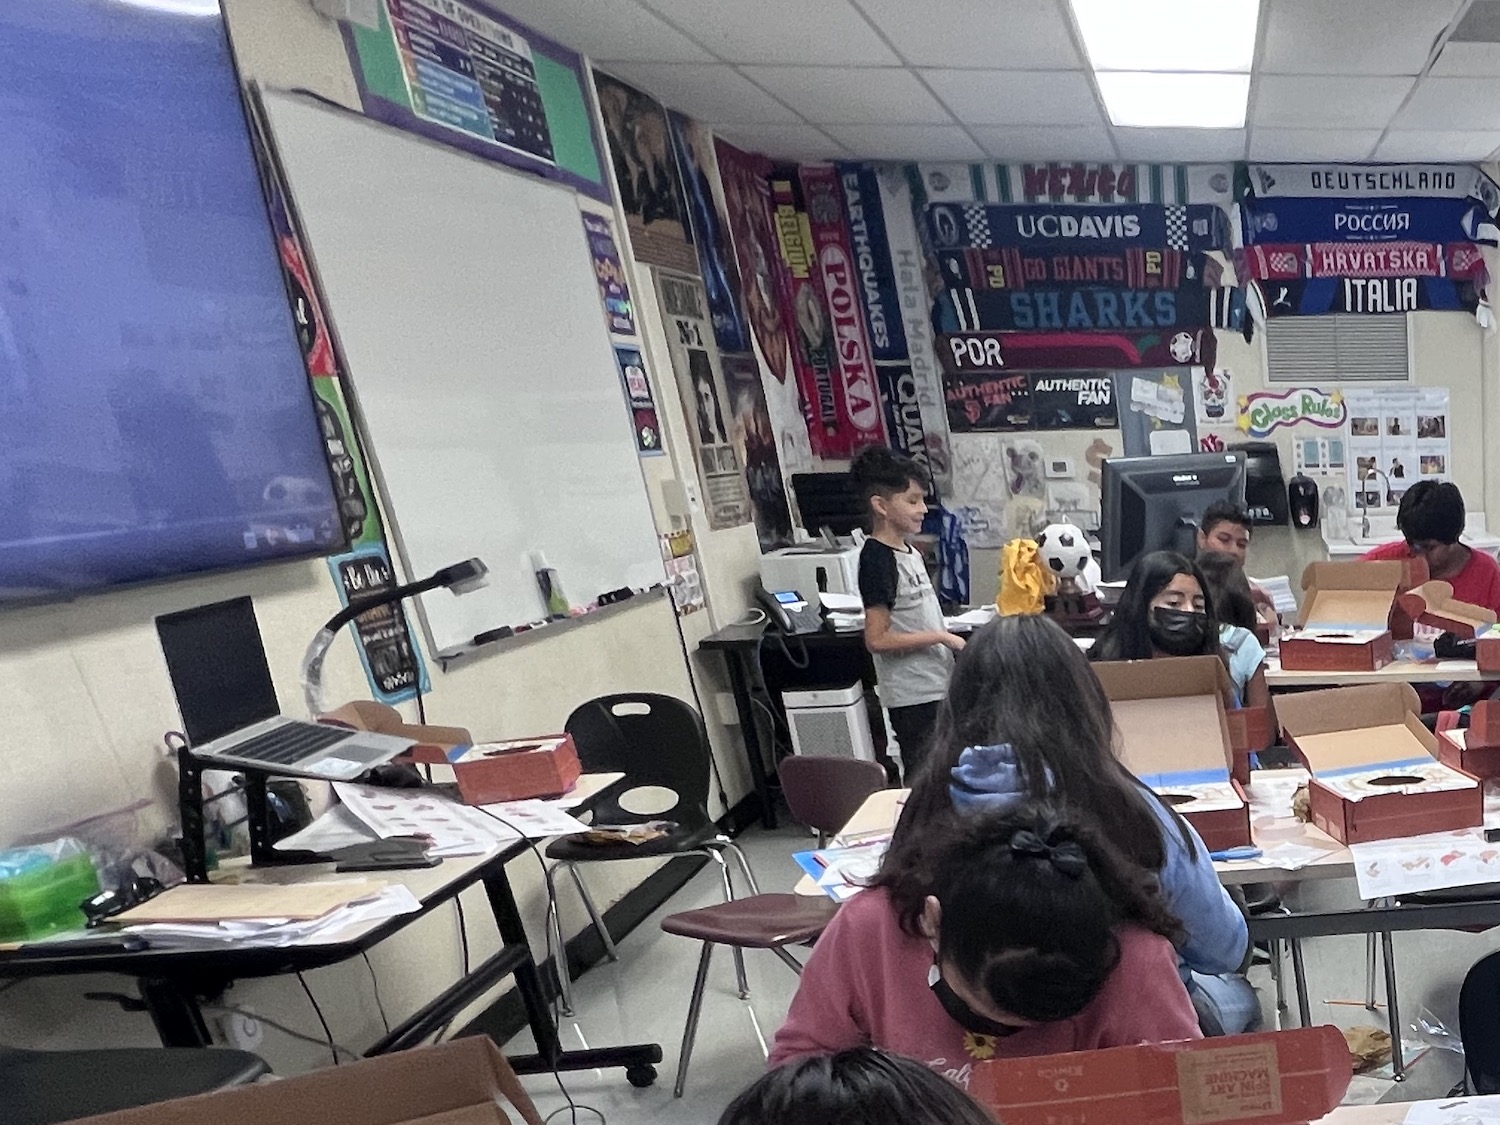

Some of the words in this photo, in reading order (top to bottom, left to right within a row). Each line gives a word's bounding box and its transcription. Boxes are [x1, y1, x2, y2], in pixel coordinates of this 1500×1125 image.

[1311, 171, 1456, 190] DEUTSCHLAND
[1334, 212, 1411, 232] РОССИЯ
[843, 174, 890, 349] EARTHQUAKES
[1024, 258, 1047, 281] GO
[1053, 256, 1125, 282] GIANTS
[1323, 250, 1429, 272] HRVATSKA
[1344, 277, 1418, 313] ITALIA
[1010, 290, 1178, 329] SHARKS
[825, 262, 873, 416] POLSKA
[949, 337, 1005, 368] POR
[946, 376, 1027, 401] AUTHENTIC
[1034, 377, 1112, 393] AUTHENTIC
[982, 392, 1014, 408] FAN
[1076, 390, 1112, 406] FAN
[1250, 402, 1299, 429] Class
[1300, 393, 1341, 420] Rules
[1208, 1082, 1236, 1096] ART
